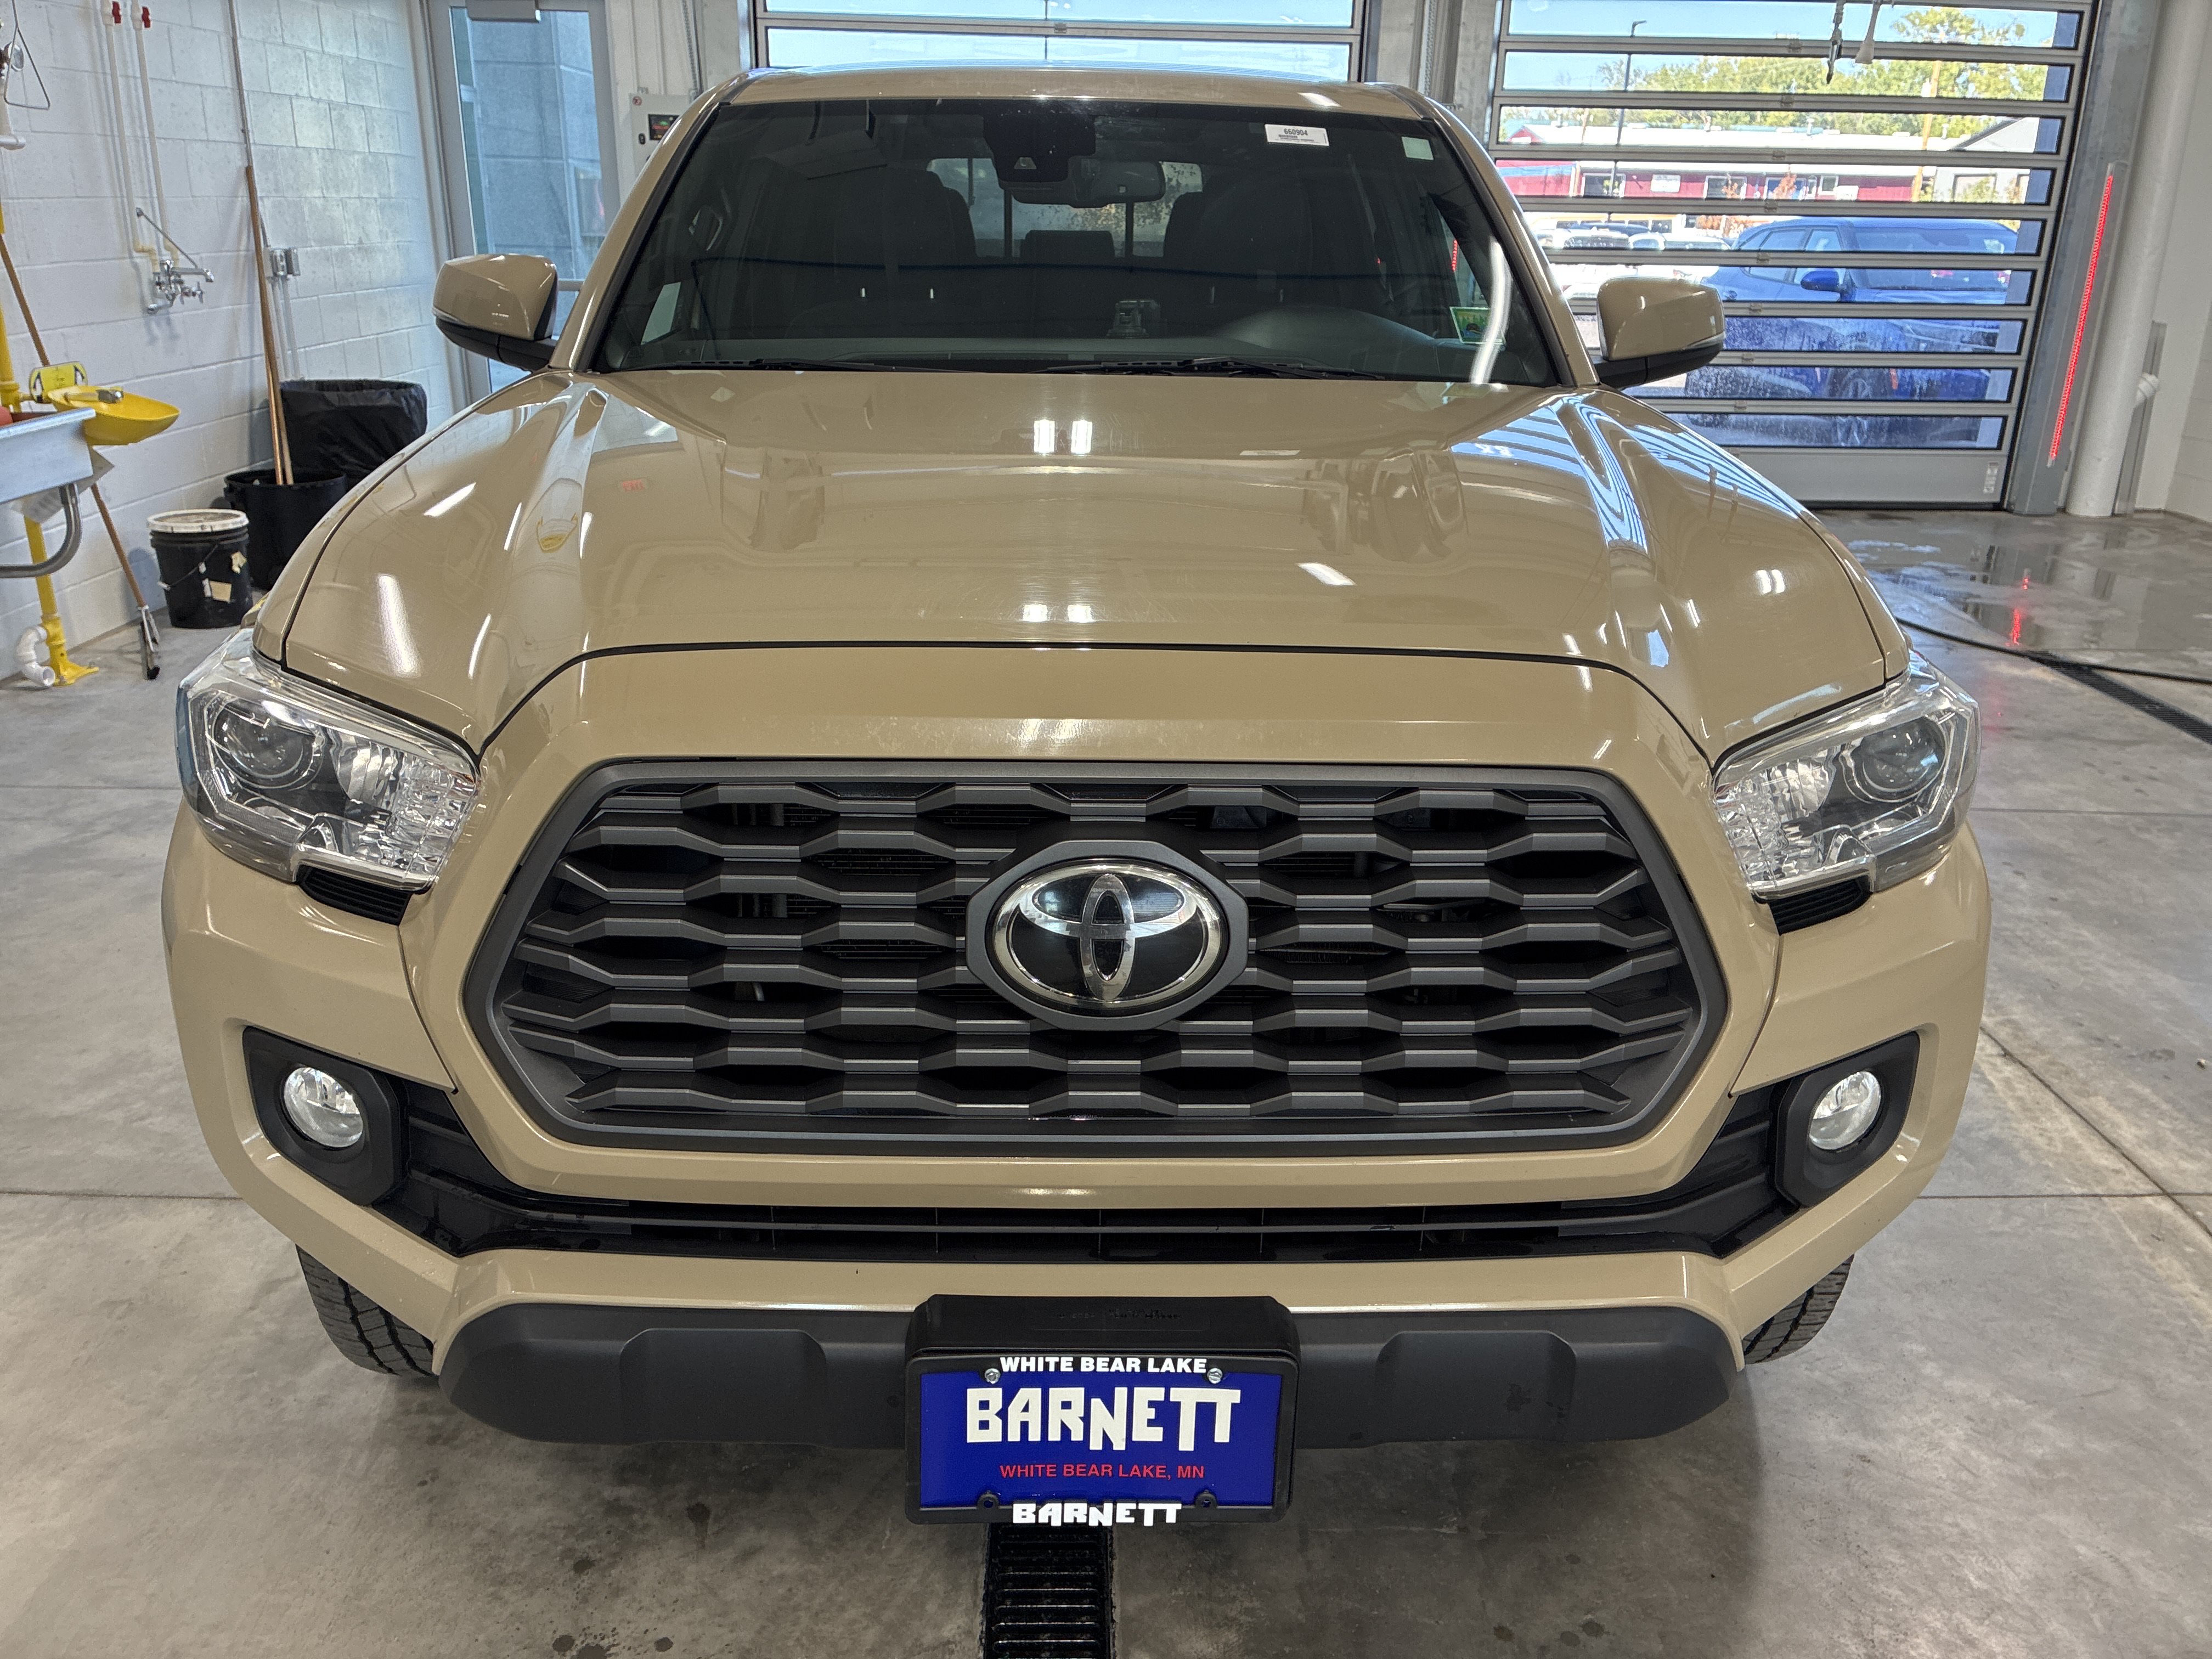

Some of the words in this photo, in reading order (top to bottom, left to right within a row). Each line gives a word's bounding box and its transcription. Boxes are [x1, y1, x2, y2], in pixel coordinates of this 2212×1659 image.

[1000, 1357, 1074, 1372] WHITE
[1080, 1357, 1141, 1373] BEAR
[1147, 1357, 1207, 1373] LAKE
[966, 1386, 1242, 1451] BARNETT
[1000, 1464, 1057, 1478] WHITE
[1063, 1464, 1112, 1477] BEAR
[1119, 1464, 1172, 1480] LAKE,
[1177, 1465, 1204, 1479] MN
[1012, 1503, 1182, 1526] BARNETT
